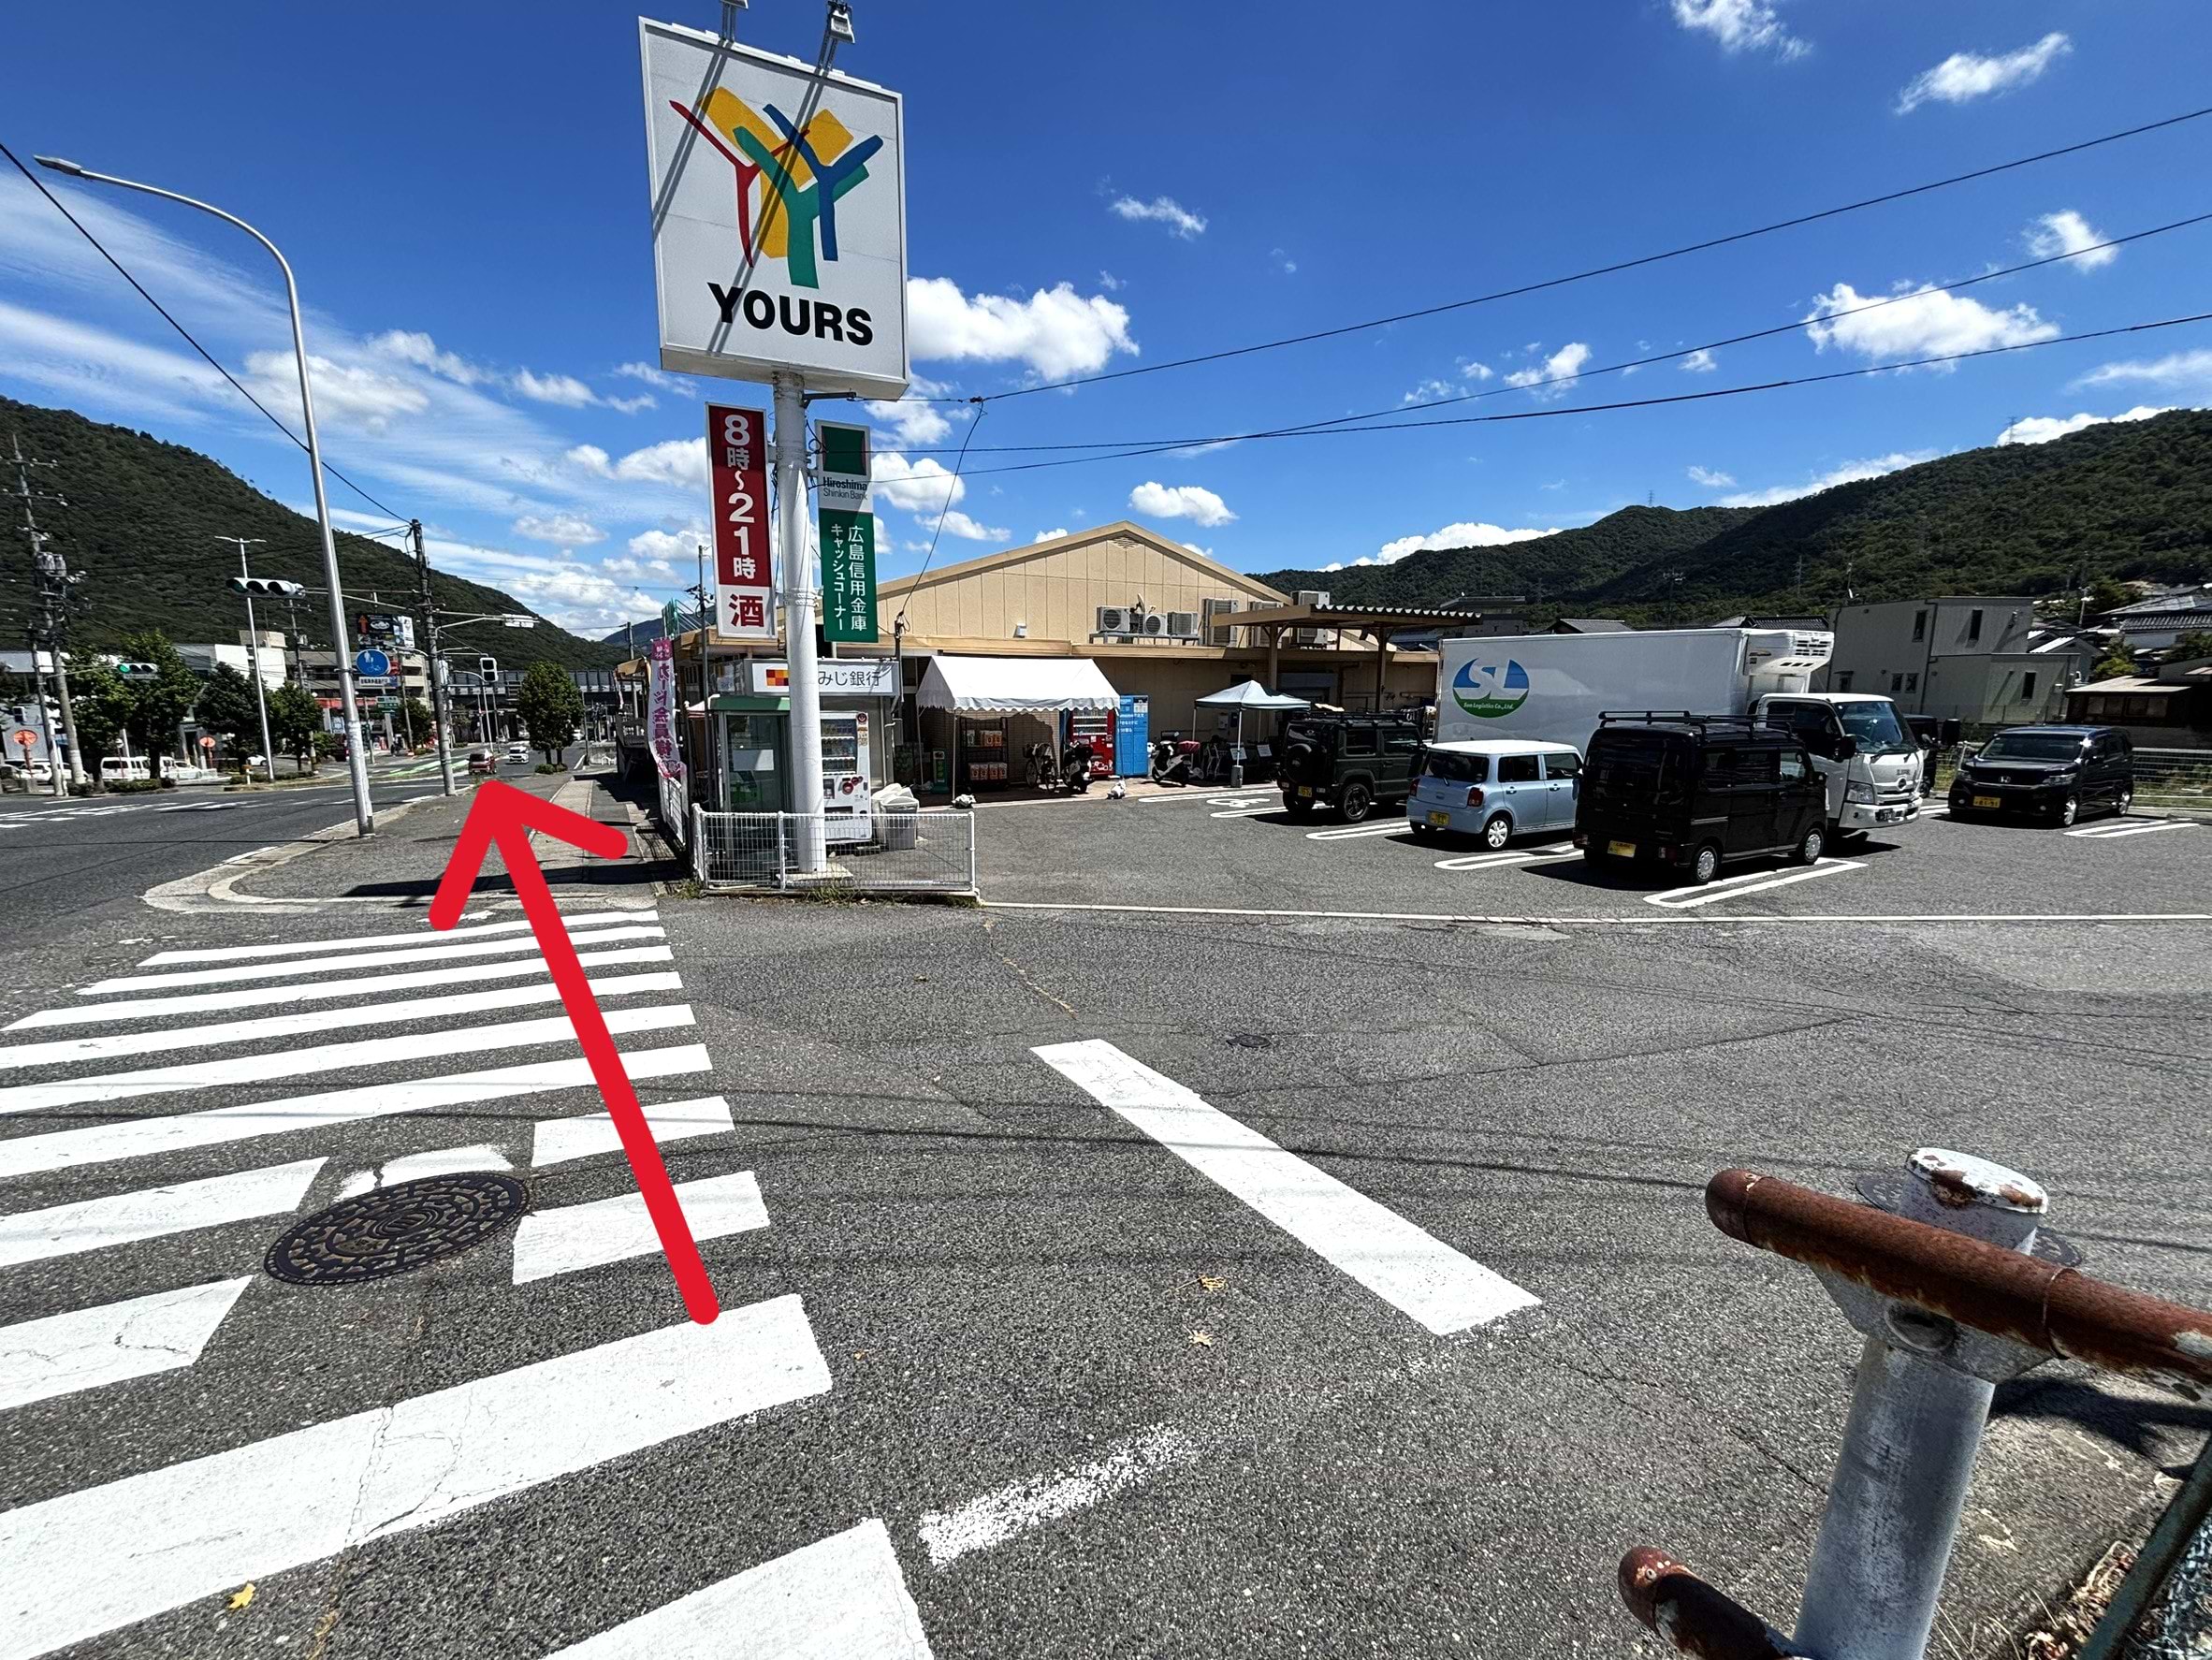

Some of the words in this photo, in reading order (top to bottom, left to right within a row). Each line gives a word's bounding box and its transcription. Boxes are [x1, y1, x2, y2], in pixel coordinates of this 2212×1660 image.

[706, 281, 874, 346] YOURS
[822, 476, 868, 491] Hiroshima
[822, 488, 850, 500] Shinkin
[850, 489, 868, 501] Bank
[829, 522, 847, 632] キャッシュコーナー
[848, 524, 868, 633] 広島信用金庫
[728, 592, 764, 628] 酒
[817, 670, 881, 687] みじ銀行
